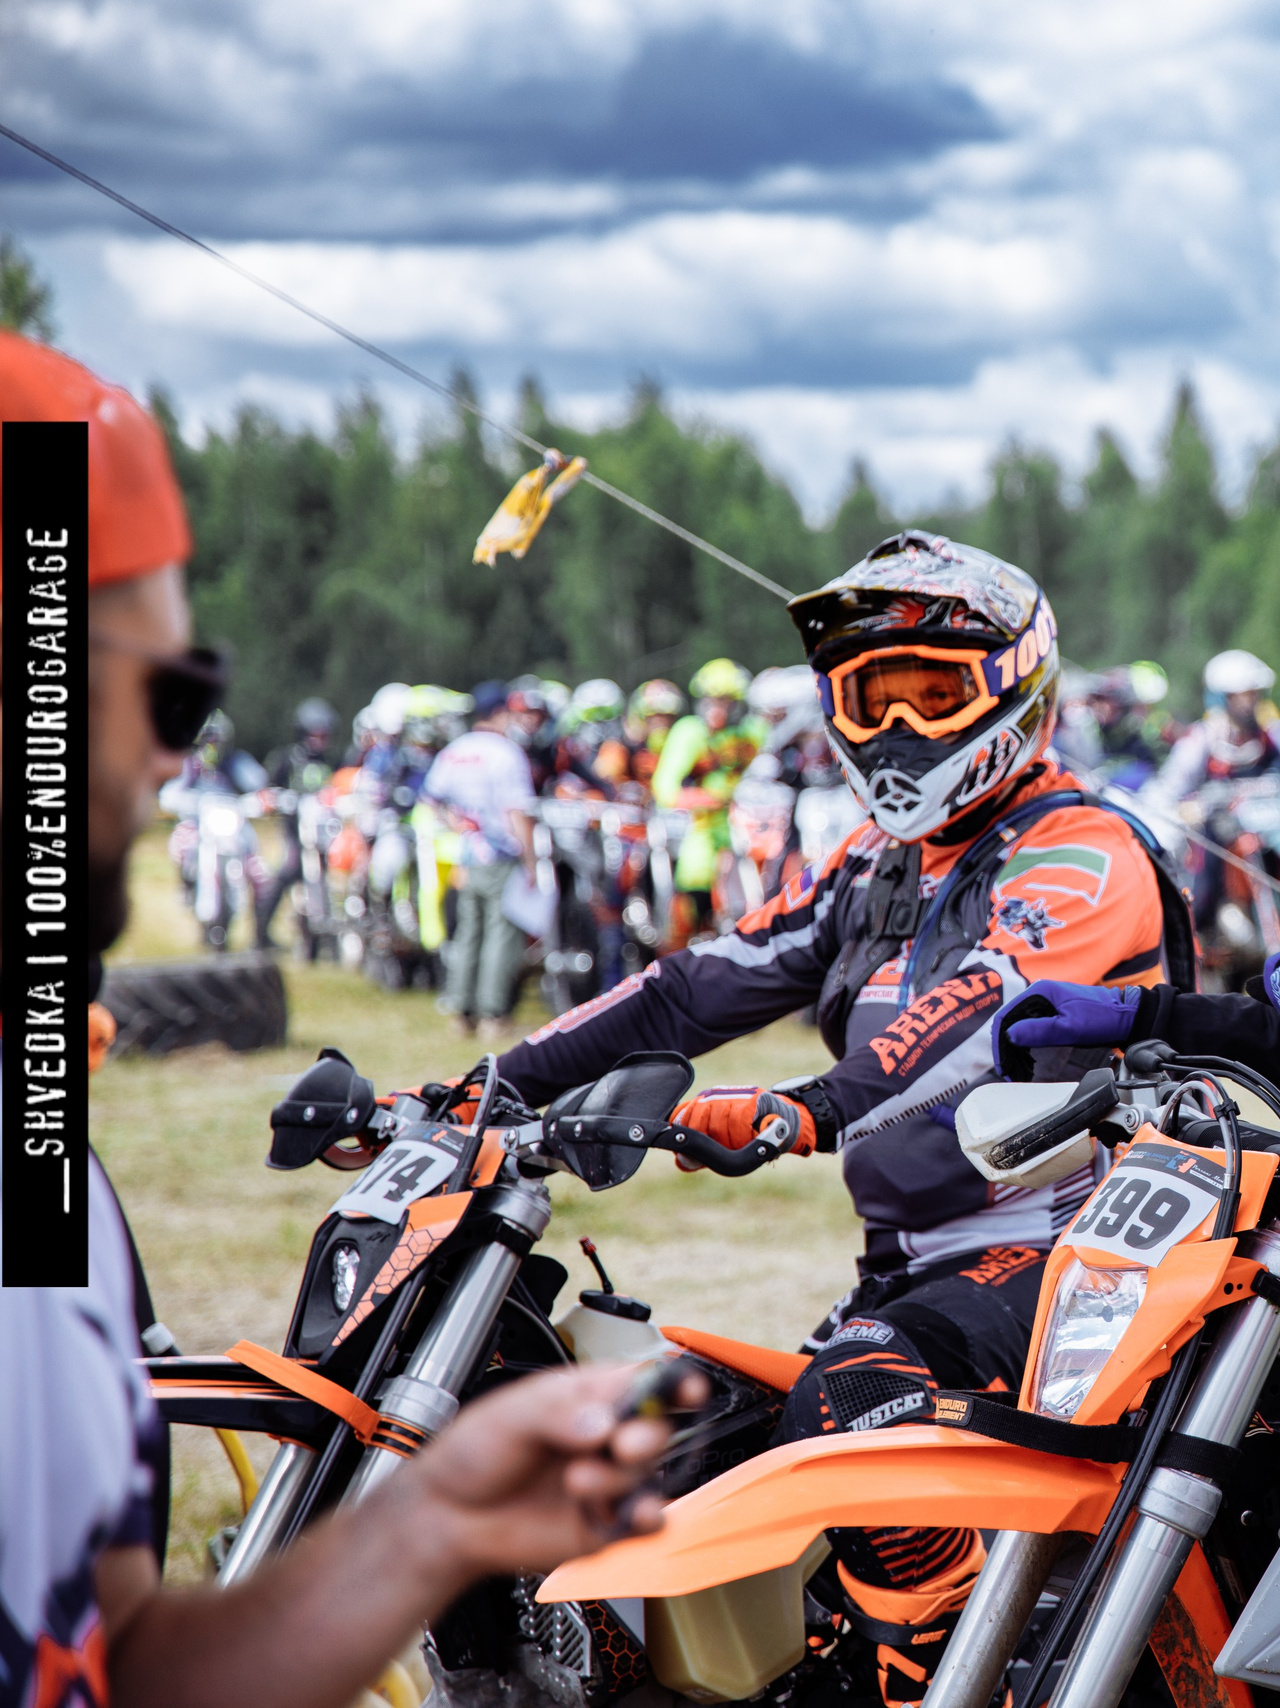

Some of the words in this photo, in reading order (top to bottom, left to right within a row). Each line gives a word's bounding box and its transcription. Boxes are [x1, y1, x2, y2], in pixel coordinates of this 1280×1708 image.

[869, 970, 1003, 1076] ARENA
[346, 1148, 436, 1203] 74
[1072, 1176, 1191, 1250] 399
